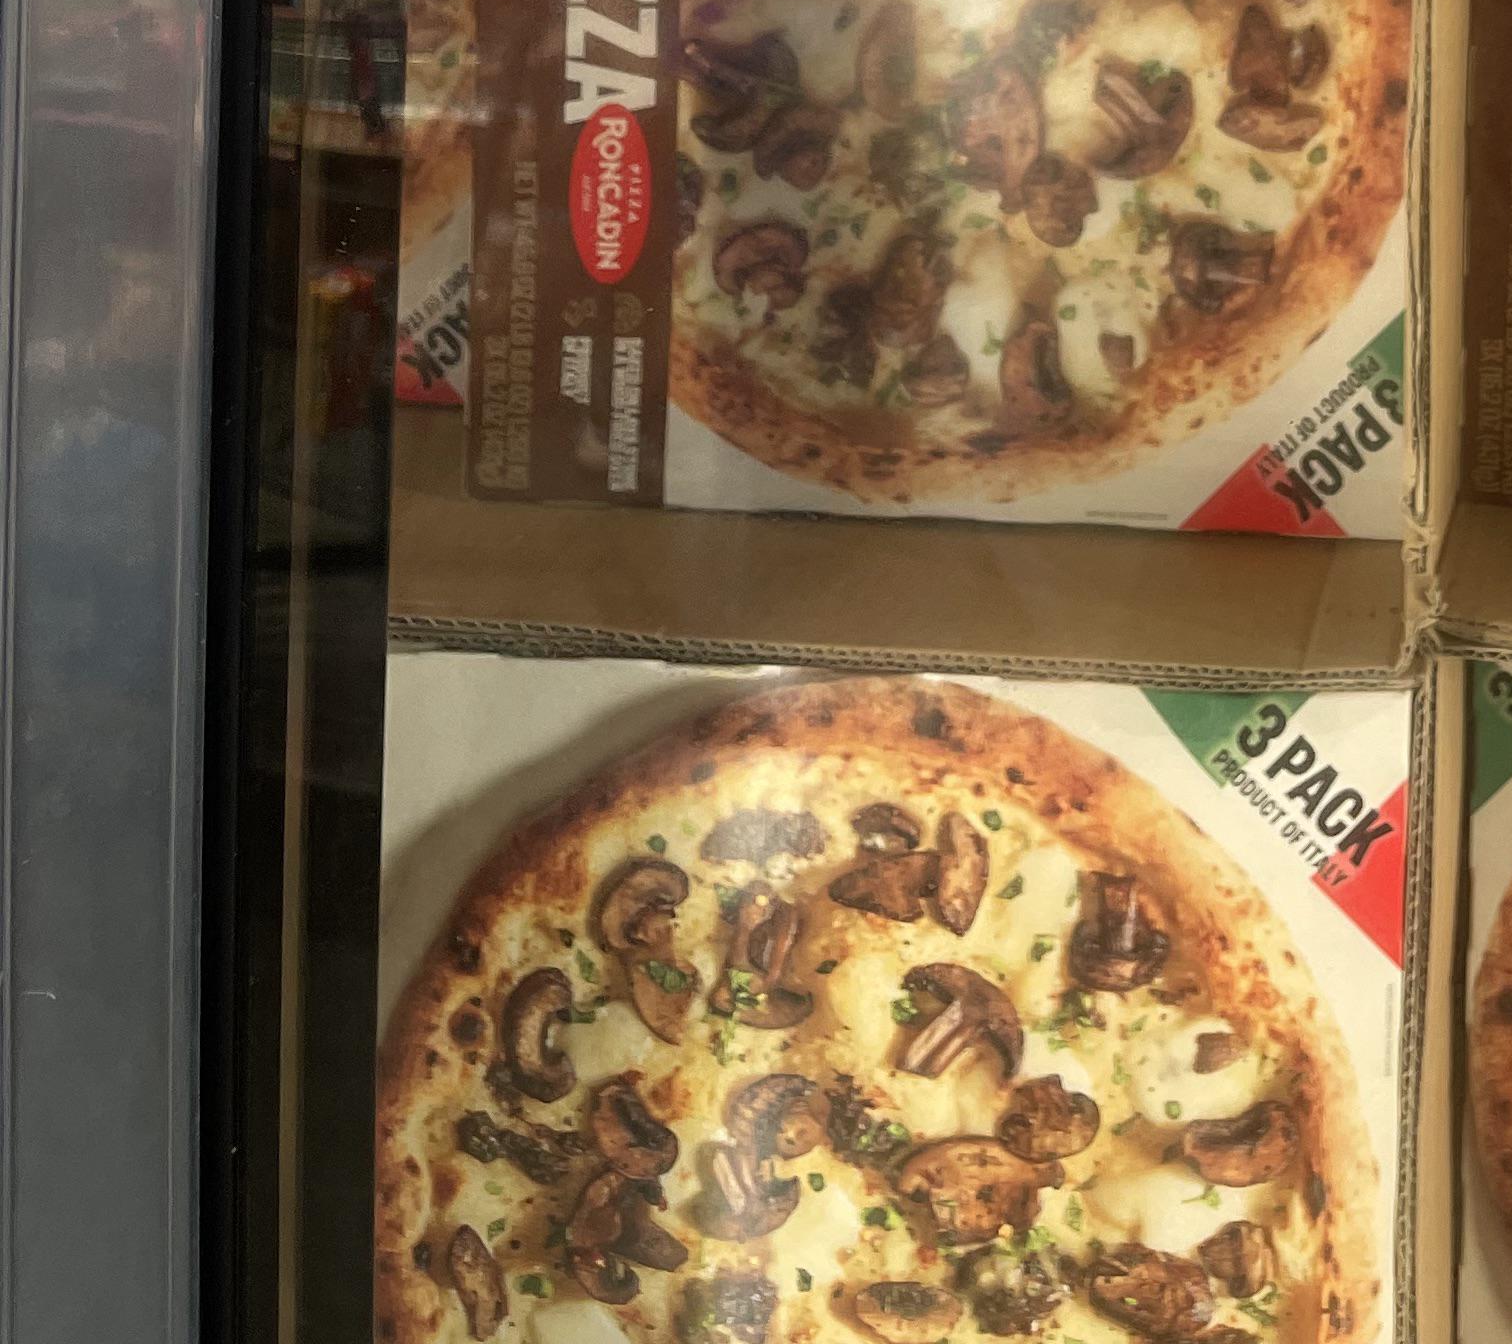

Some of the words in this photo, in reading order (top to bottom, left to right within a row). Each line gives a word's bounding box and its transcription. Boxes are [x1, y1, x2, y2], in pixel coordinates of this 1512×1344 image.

[592, 116, 628, 271] RONCADIN
[1297, 414, 1318, 441] OF
[1313, 355, 1380, 424] PRODUCT
[1273, 403, 1393, 523] PACK
[1212, 748, 1286, 826] PRODUCT
[1280, 821, 1306, 846] OF
[1298, 837, 1348, 888] ITALY
[1236, 703, 1287, 758] 3
[1265, 734, 1394, 867] PACK
